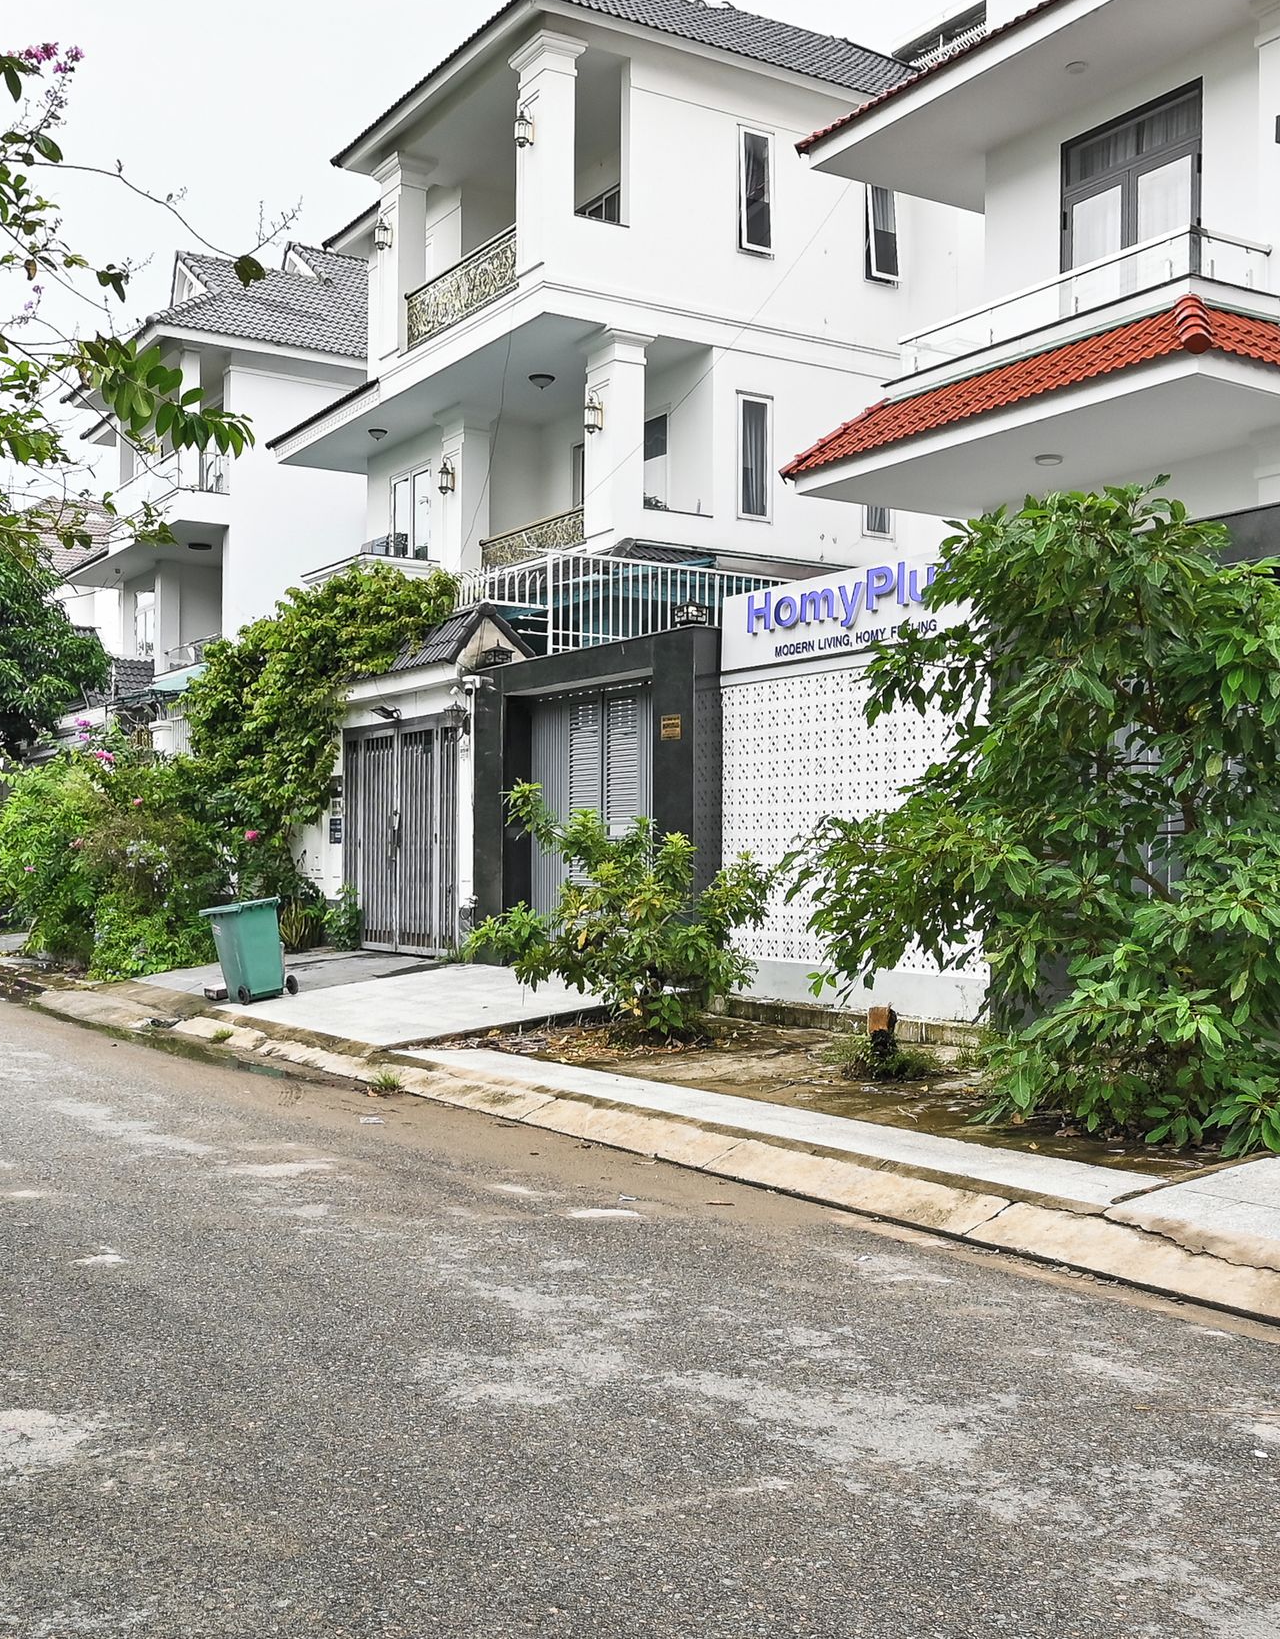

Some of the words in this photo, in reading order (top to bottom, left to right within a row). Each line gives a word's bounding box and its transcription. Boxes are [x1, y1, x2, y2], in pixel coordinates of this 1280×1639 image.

[747, 561, 957, 634] HomyPlu
[775, 640, 815, 658] MODERN
[818, 633, 853, 650] LIVING,
[855, 627, 886, 644] HOMY
